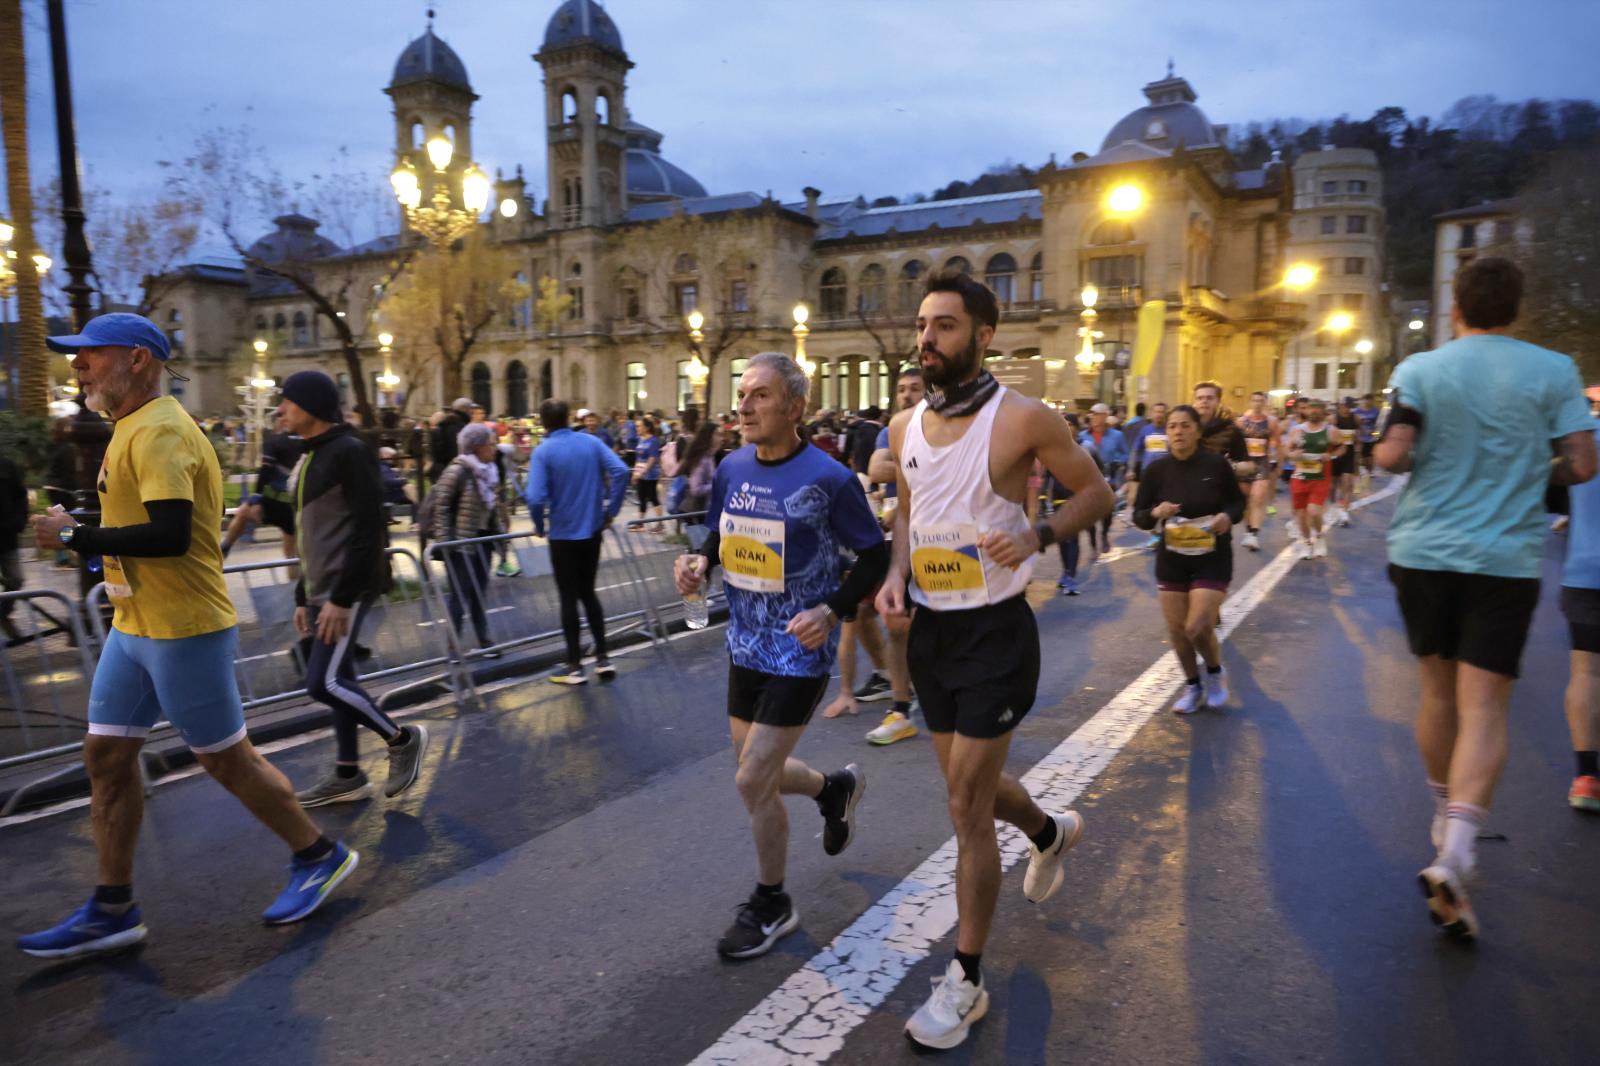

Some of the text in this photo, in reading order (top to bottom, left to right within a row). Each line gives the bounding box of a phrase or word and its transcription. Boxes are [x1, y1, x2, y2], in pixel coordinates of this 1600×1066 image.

[739, 525, 771, 537] ZURICH
[922, 531, 960, 544] ZURICH
[924, 559, 961, 574] IÑAKI
